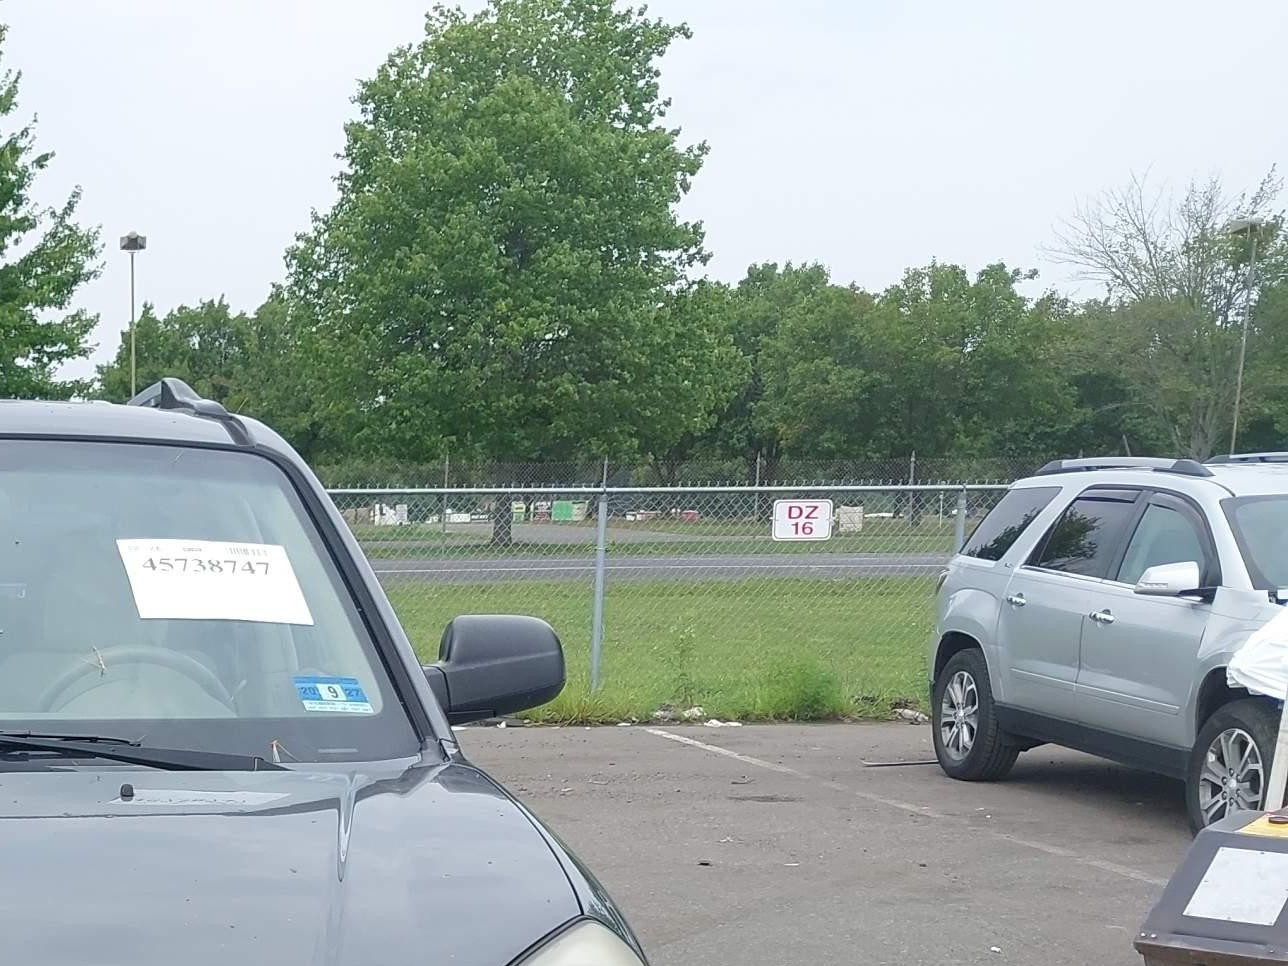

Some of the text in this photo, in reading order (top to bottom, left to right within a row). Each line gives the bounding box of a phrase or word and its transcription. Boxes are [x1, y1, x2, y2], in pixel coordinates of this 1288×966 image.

[788, 505, 819, 520] DZ
[791, 521, 814, 535] 16
[141, 557, 269, 575] 45738747
[327, 686, 339, 698] 9
